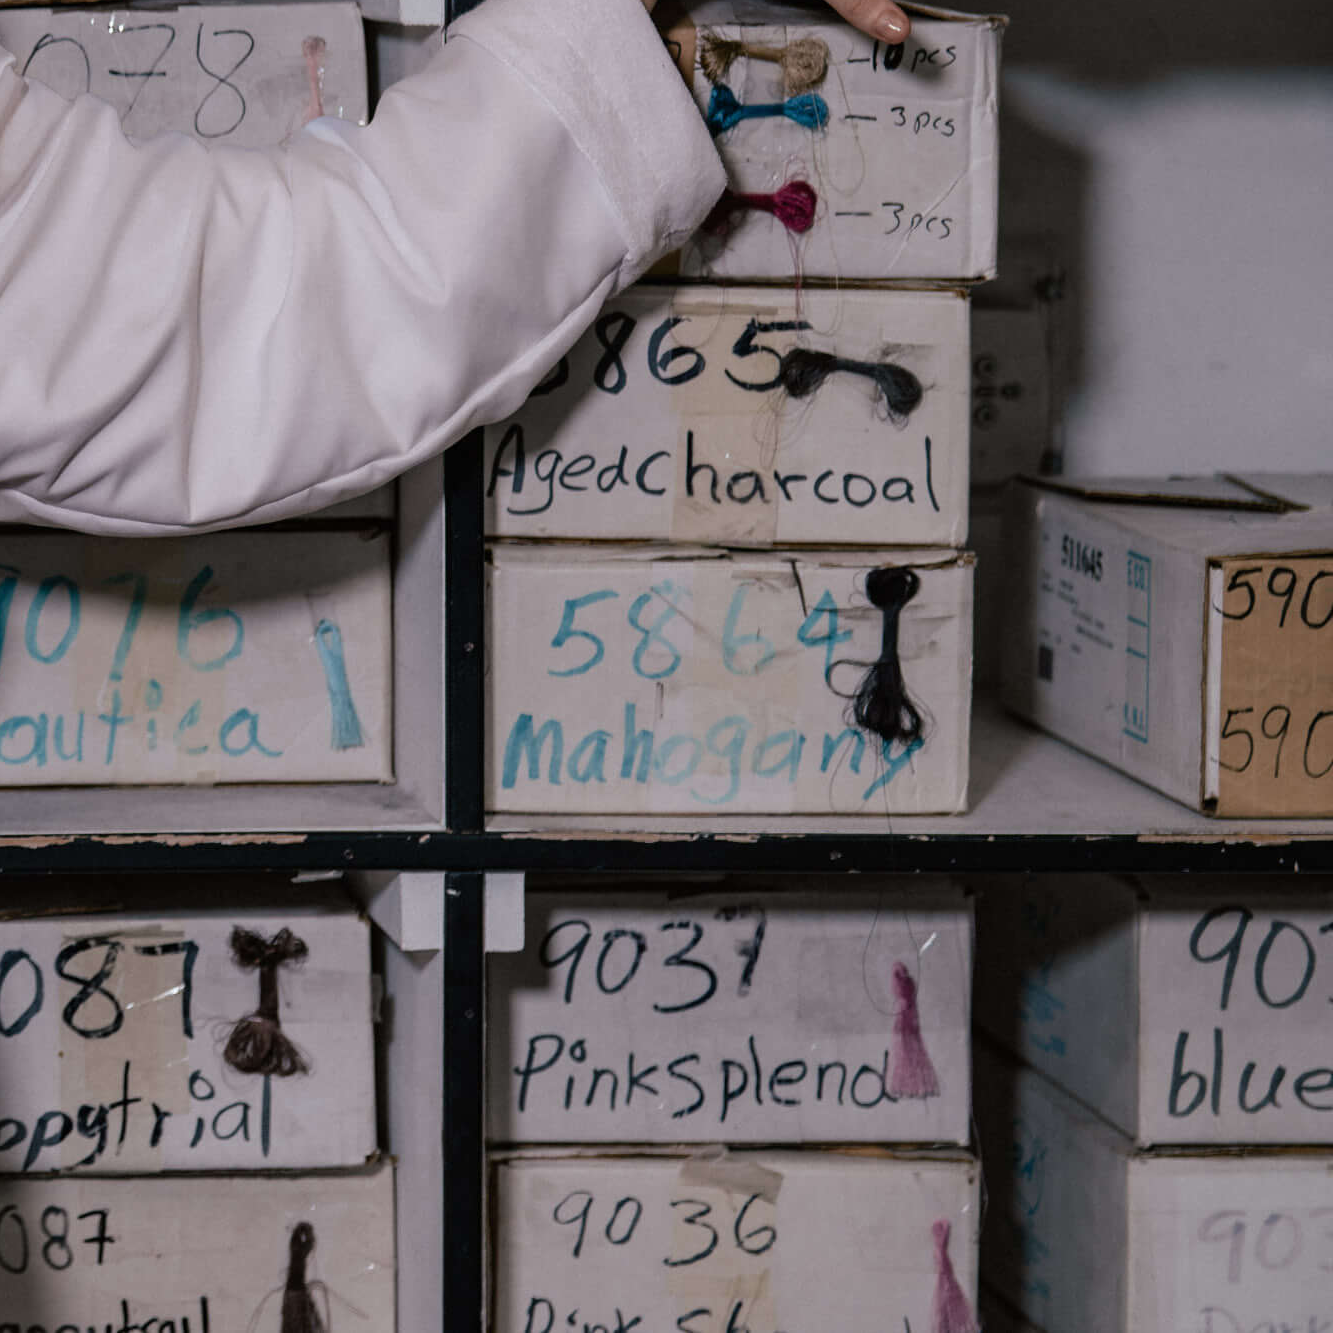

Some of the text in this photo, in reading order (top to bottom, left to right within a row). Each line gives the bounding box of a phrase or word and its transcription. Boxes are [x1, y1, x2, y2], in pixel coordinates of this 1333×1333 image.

[546, 577, 854, 683] 5864
[501, 701, 926, 805] Mahogany
[539, 907, 766, 1014] 9037
[553, 1191, 777, 1268] 9036
